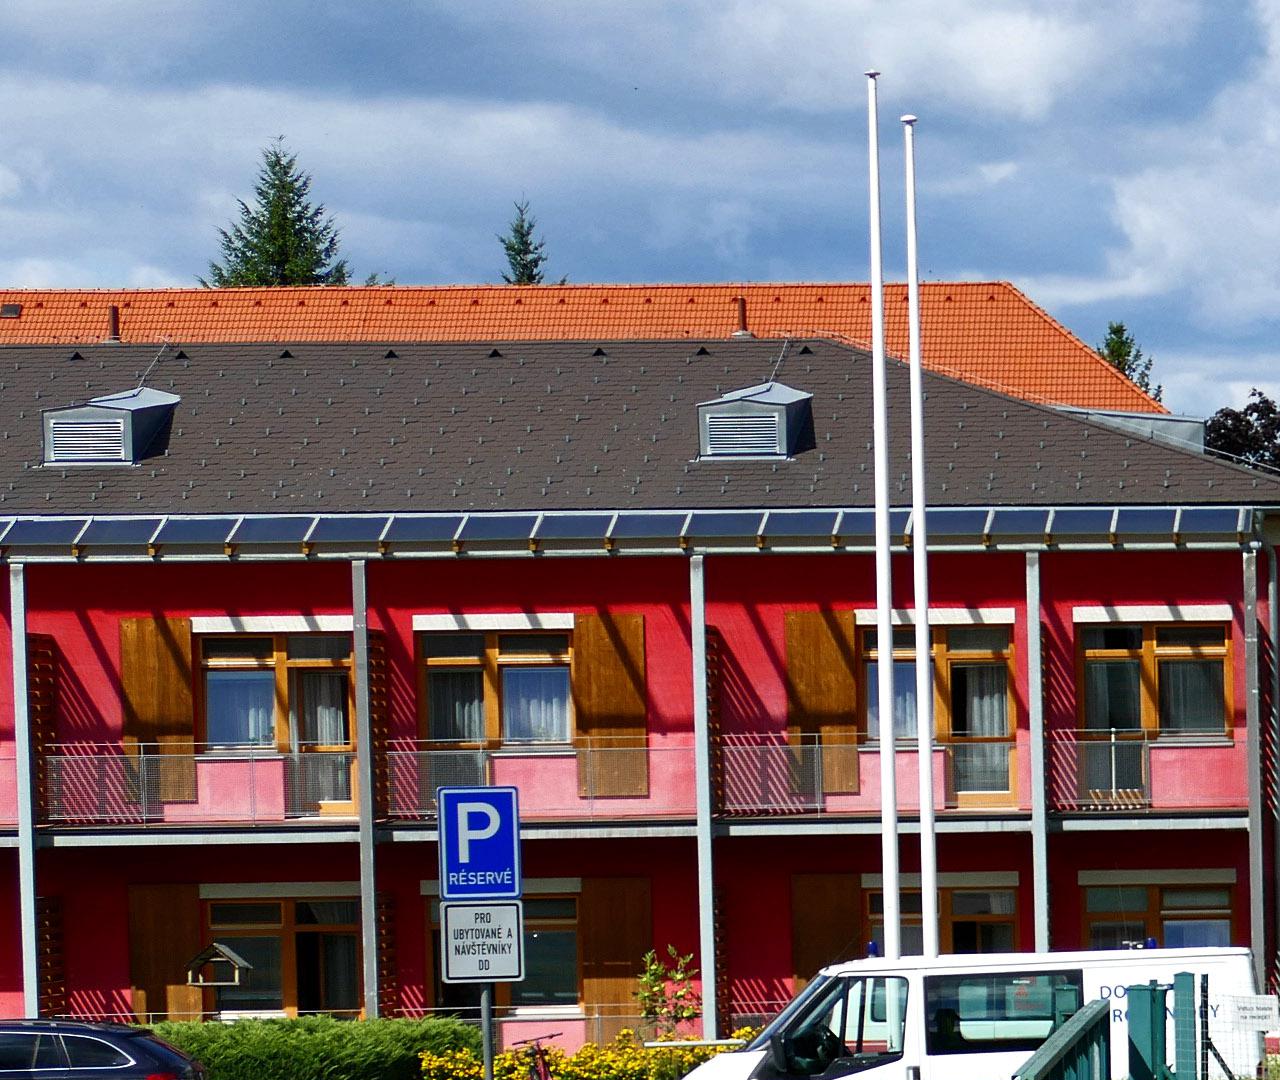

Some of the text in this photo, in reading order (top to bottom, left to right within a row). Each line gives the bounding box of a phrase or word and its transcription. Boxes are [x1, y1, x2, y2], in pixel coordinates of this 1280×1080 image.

[457, 802, 501, 863] P
[449, 868, 512, 885] RÉSERVÉ
[474, 912, 491, 924] PRO
[453, 925, 513, 940] UBYTOVANÉ A
[454, 940, 513, 956] NÁVŠTĚVNÍKY
[478, 959, 490, 971] DD
